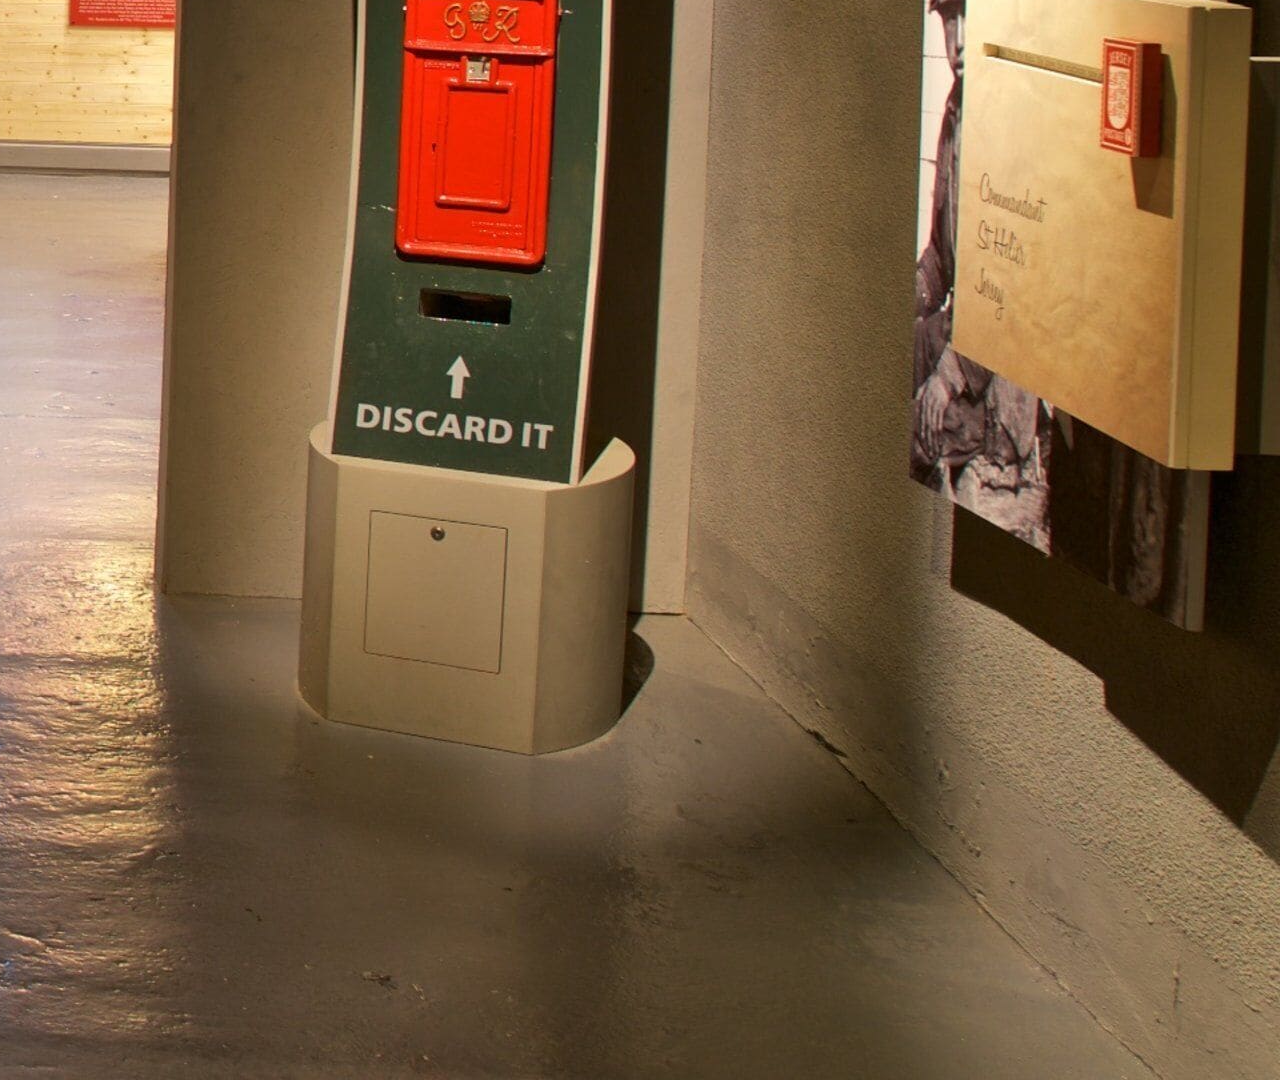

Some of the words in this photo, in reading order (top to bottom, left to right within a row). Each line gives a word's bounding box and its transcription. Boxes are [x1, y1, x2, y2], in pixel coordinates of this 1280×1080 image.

[976, 220, 994, 250] St
[356, 403, 513, 445] DISCARD
[521, 422, 554, 450] IT
